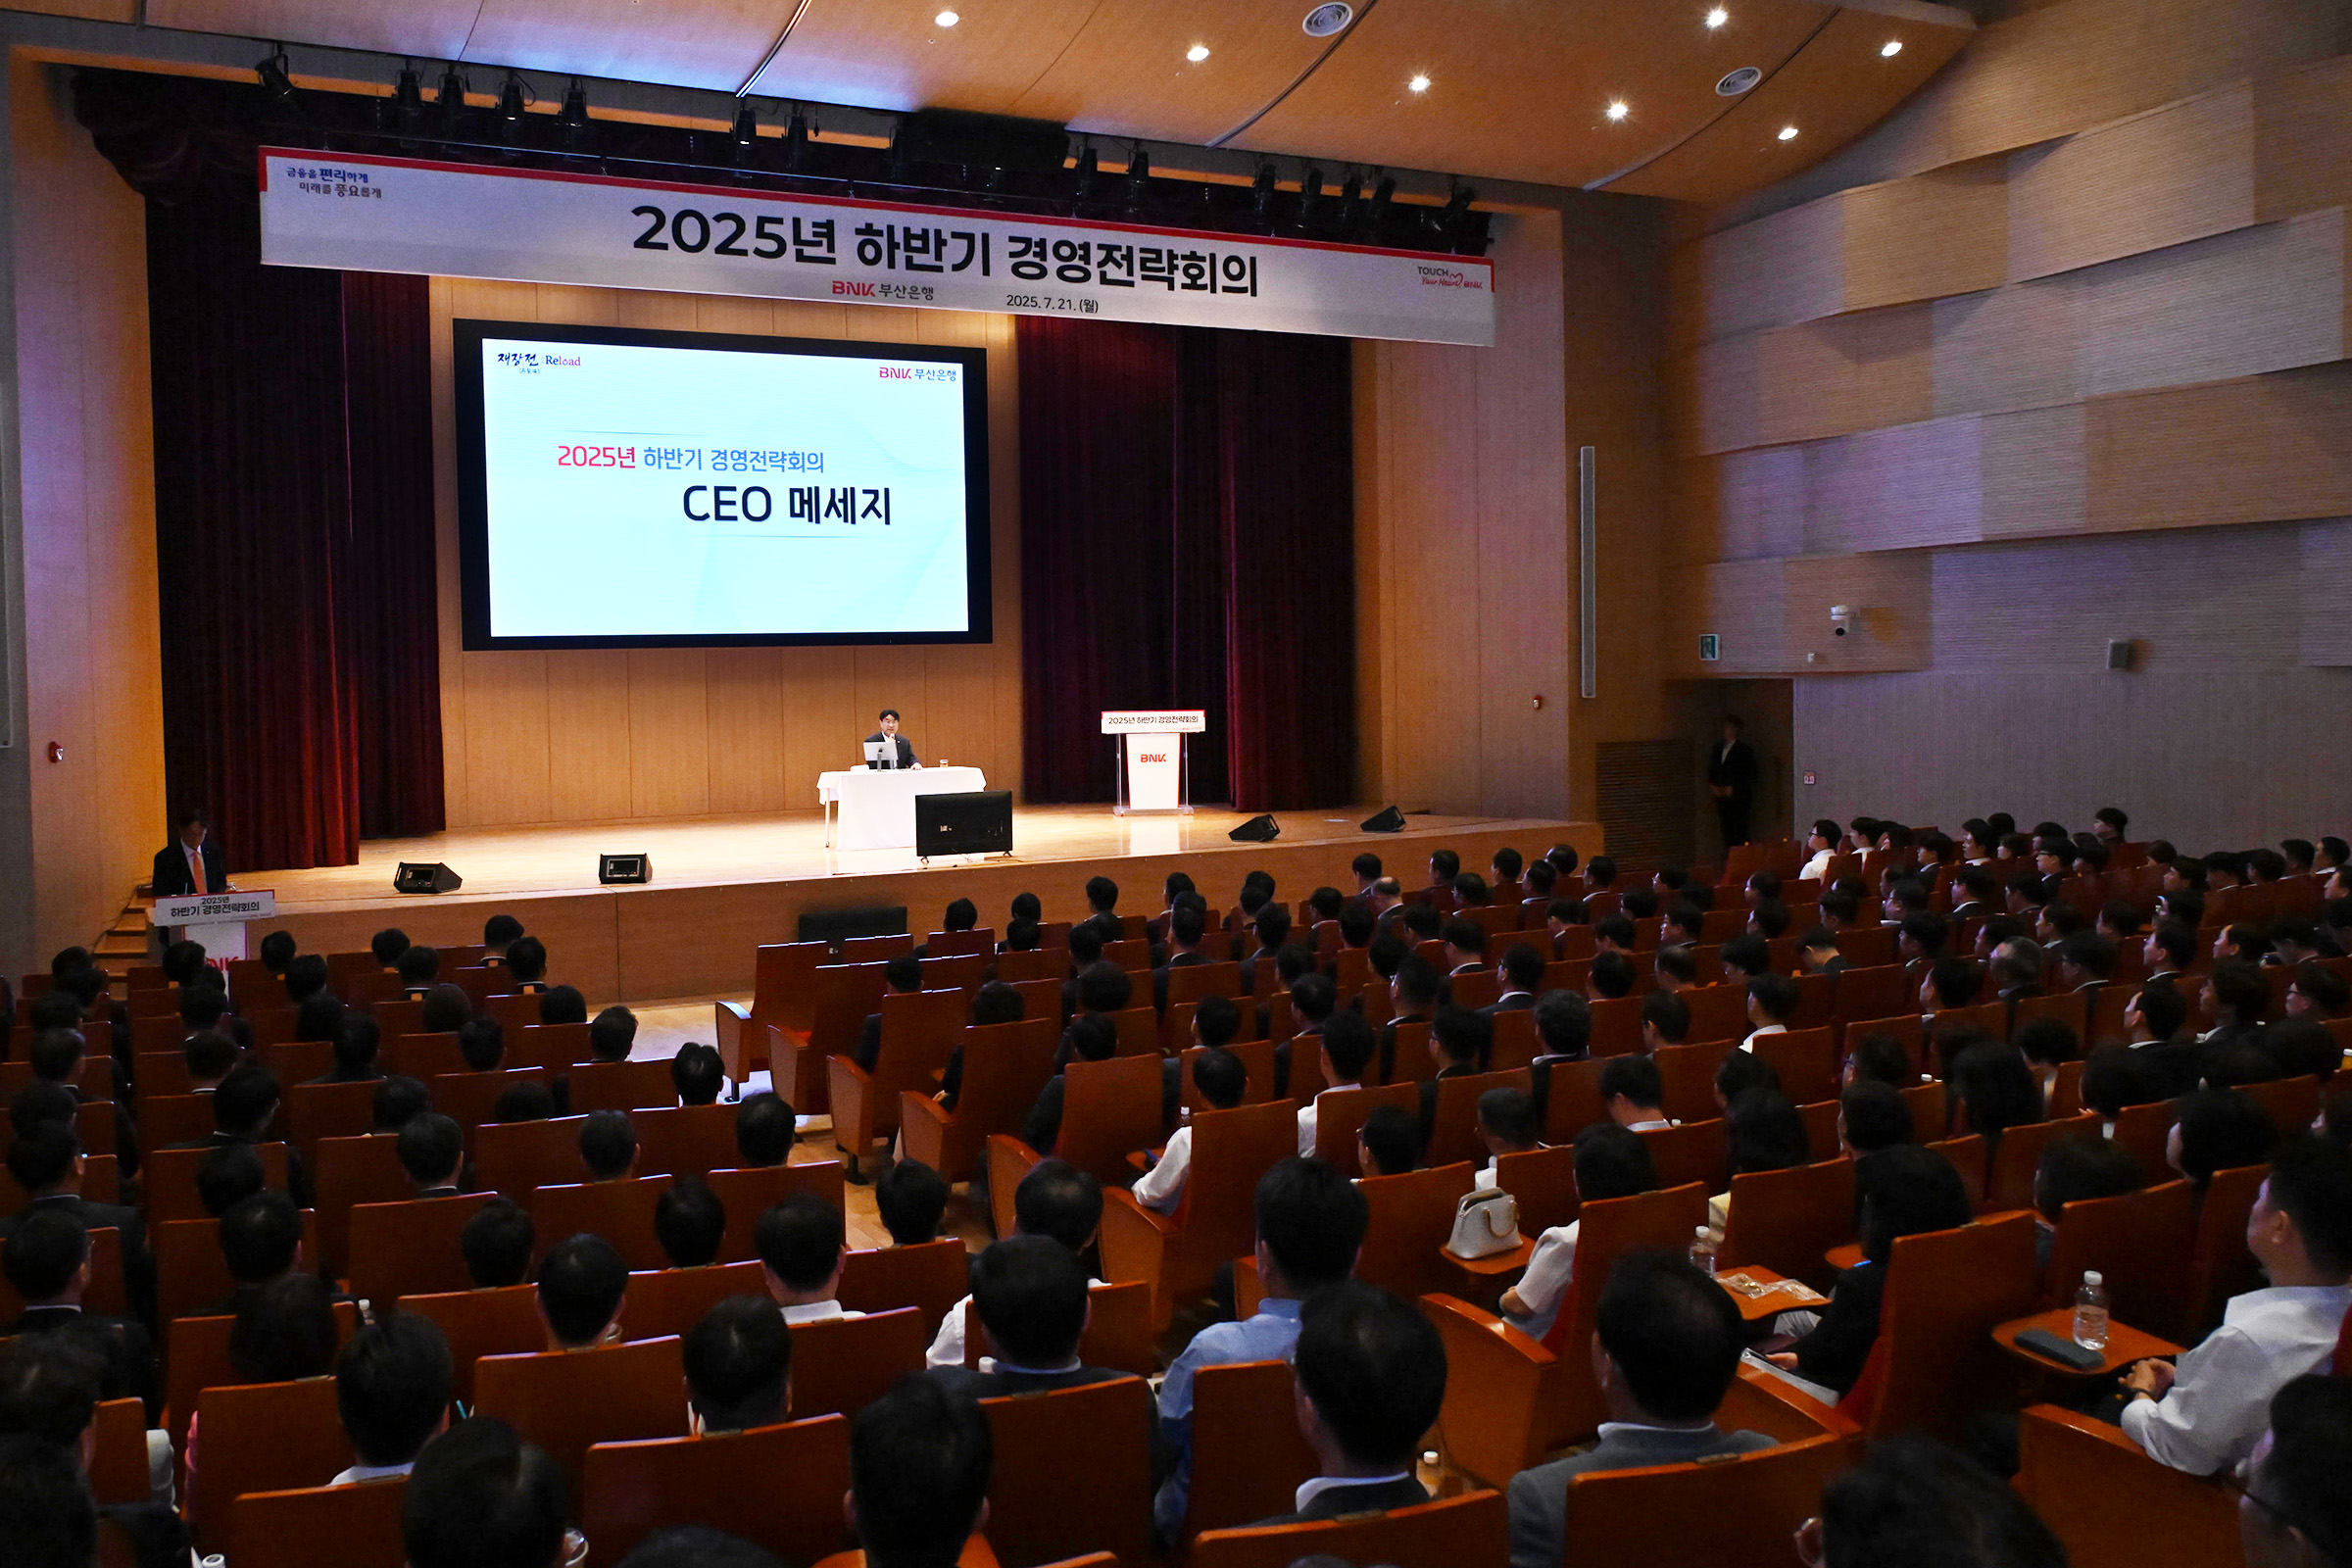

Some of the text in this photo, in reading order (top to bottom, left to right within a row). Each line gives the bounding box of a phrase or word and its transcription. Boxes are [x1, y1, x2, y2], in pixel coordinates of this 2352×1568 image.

[286, 167, 368, 183] 금융을 편리하게
[299, 182, 382, 199] 미래를 풍요롭게
[631, 205, 1257, 297] 2025년 하반기 경영전략회의
[1417, 266, 1448, 276] TOUCH
[1422, 276, 1438, 285] Your
[832, 280, 934, 301] BNK 부산은행
[497, 352, 539, 367] 재장전
[879, 367, 956, 382] BNK 부산은행
[558, 445, 824, 473] 2025년 하반기 경영전략회의
[683, 485, 891, 525] CEO 메세지
[1108, 716, 1136, 725] 2025년
[1140, 754, 1167, 762] BNK
[201, 896, 230, 905] 2025년
[171, 901, 260, 917] 하반기 경영전략회의
